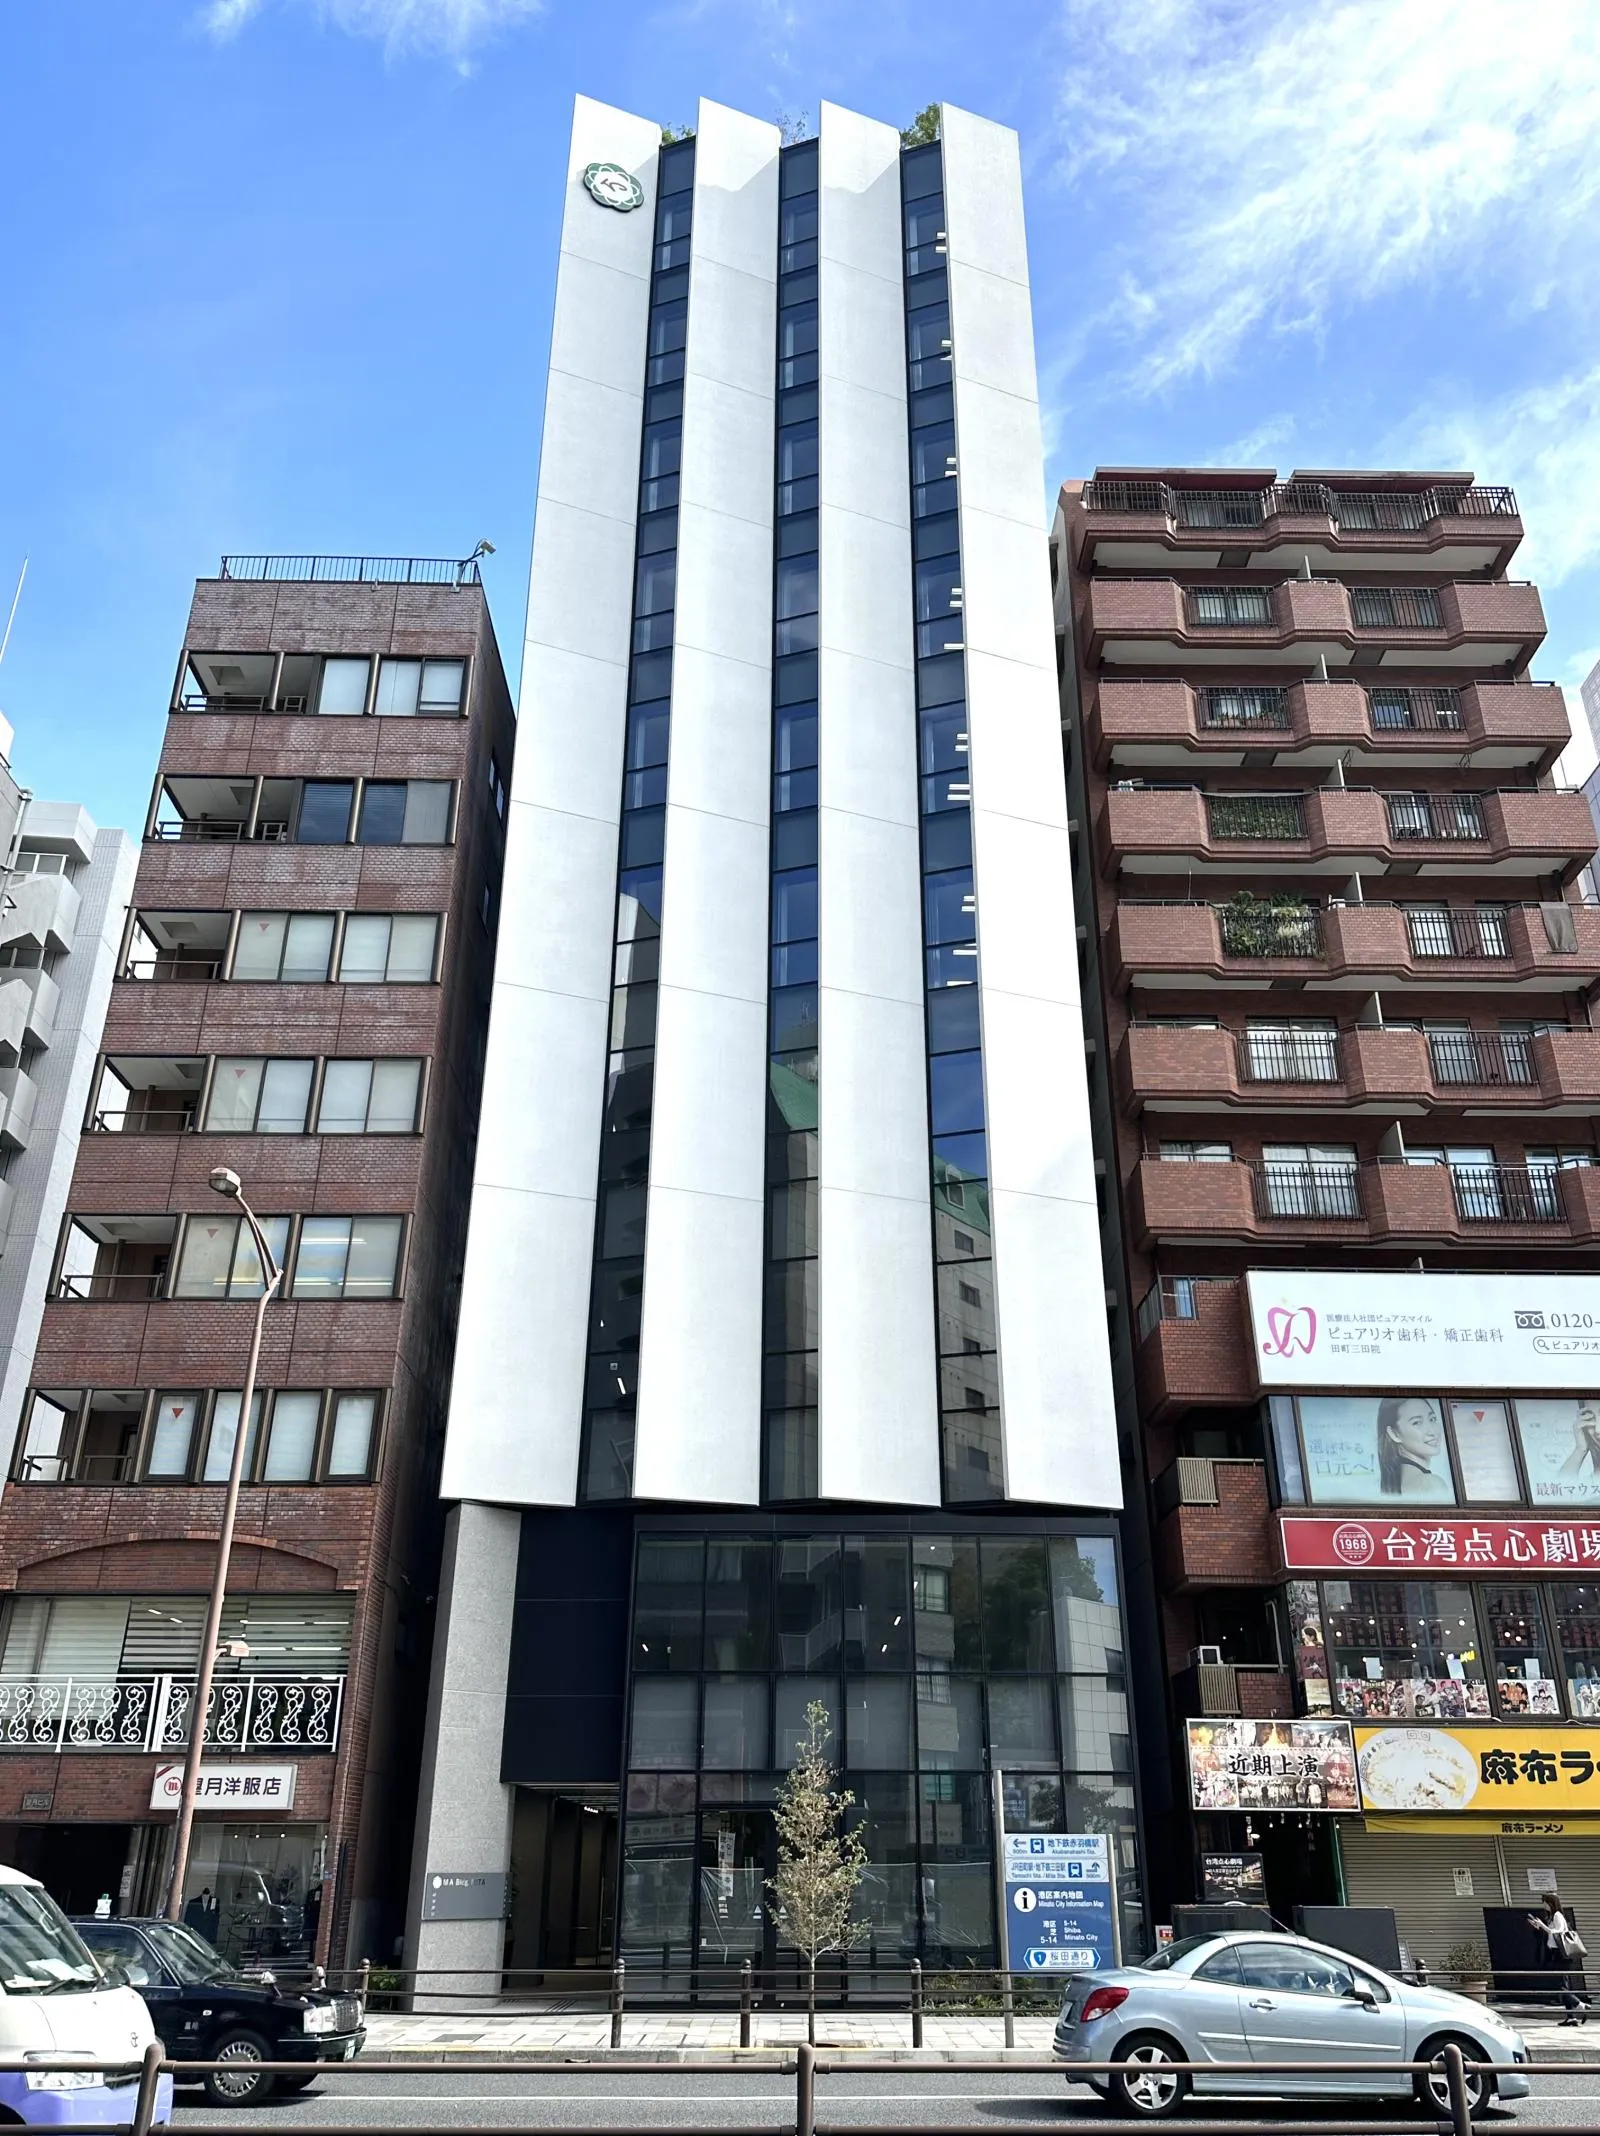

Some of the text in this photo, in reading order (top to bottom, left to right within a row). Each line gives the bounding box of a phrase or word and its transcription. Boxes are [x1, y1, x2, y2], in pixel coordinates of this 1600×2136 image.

[1339, 1538, 1368, 1550] 1968
[1228, 1753, 1321, 1778] 近期上演
[1480, 1749, 1600, 1785] 麻布ラ
[1502, 1822, 1564, 1834] 麻布ラーメン
[1038, 1890, 1084, 1900] 港区案内地図
[1055, 1901, 1065, 1909] City
[1093, 1901, 1104, 1909] Map
[1040, 1936, 1058, 1944] 5-14
[1086, 1934, 1098, 1942] City
[1050, 1951, 1088, 1961] 桜田通り
